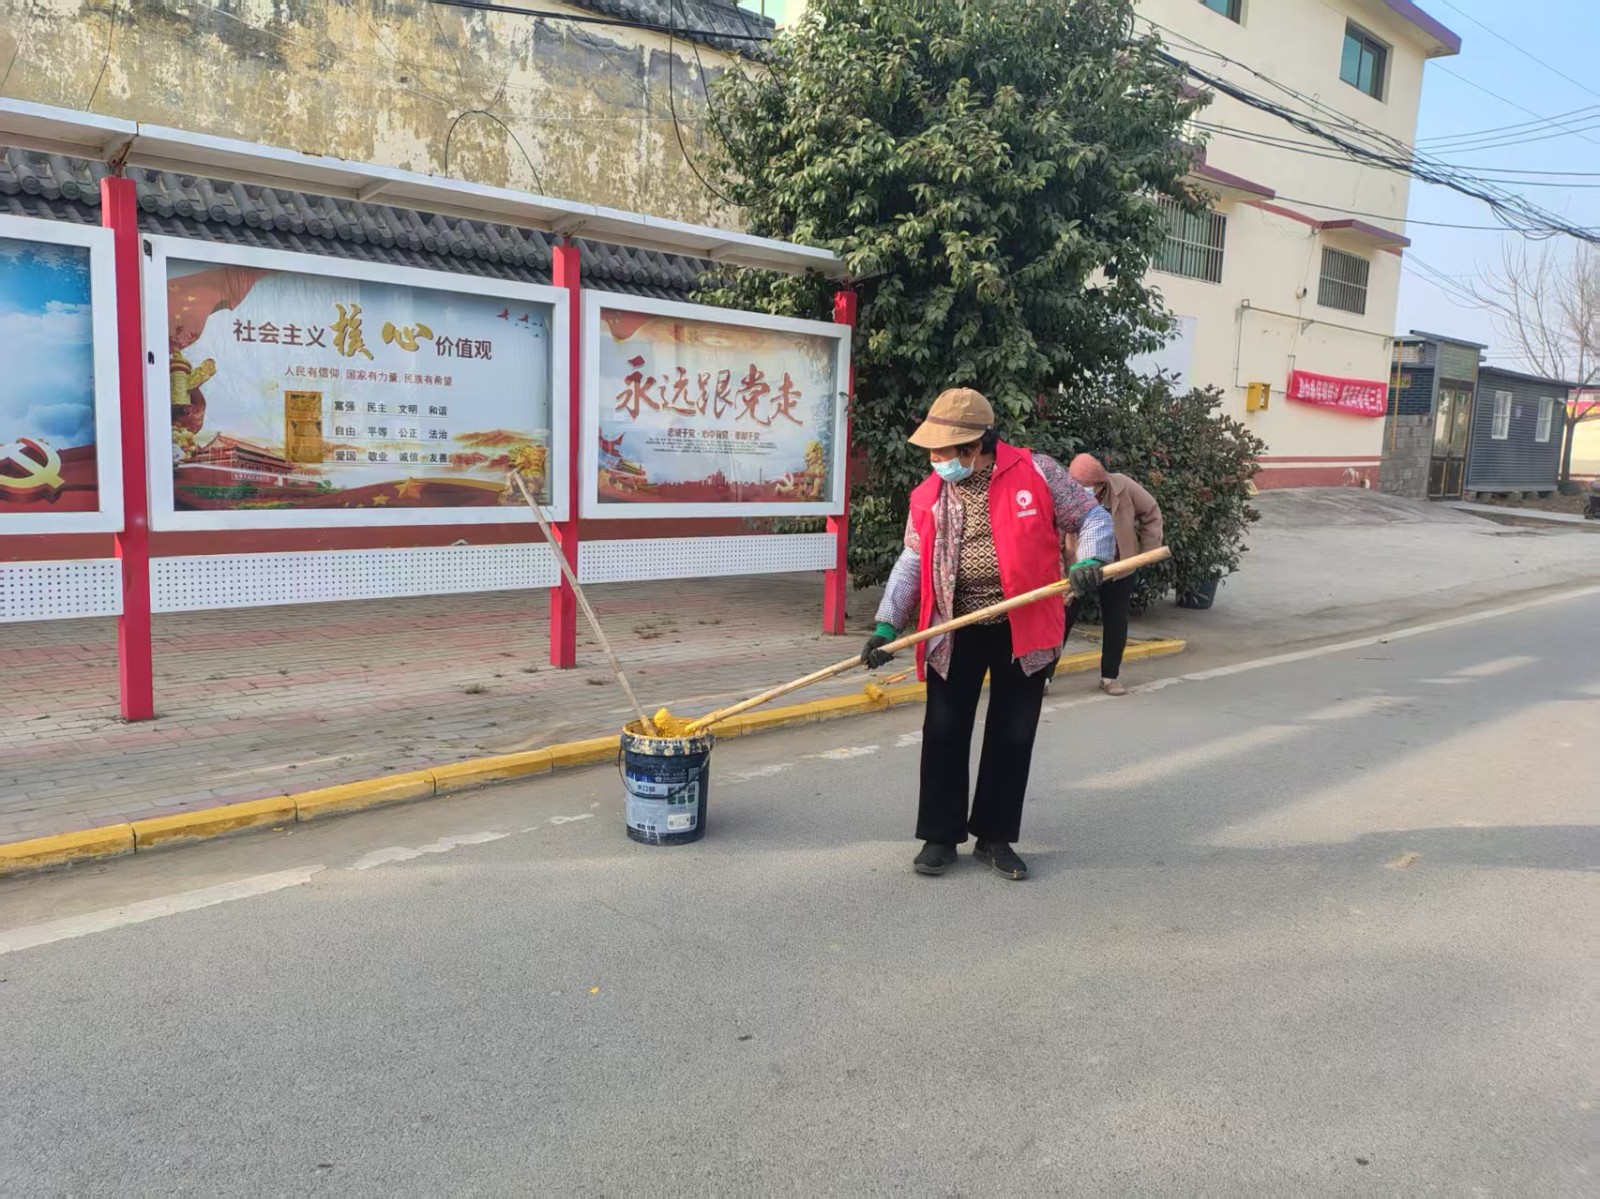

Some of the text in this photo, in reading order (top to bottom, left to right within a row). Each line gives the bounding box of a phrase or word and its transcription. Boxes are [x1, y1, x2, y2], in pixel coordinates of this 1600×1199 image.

[615, 355, 804, 427] 永远跟党走
[334, 400, 448, 416] 富强 民主 文明 和谐
[335, 425, 448, 440] 自由 平等 公正 法治
[335, 450, 448, 463] 爱国 敬业 诚信 友善
